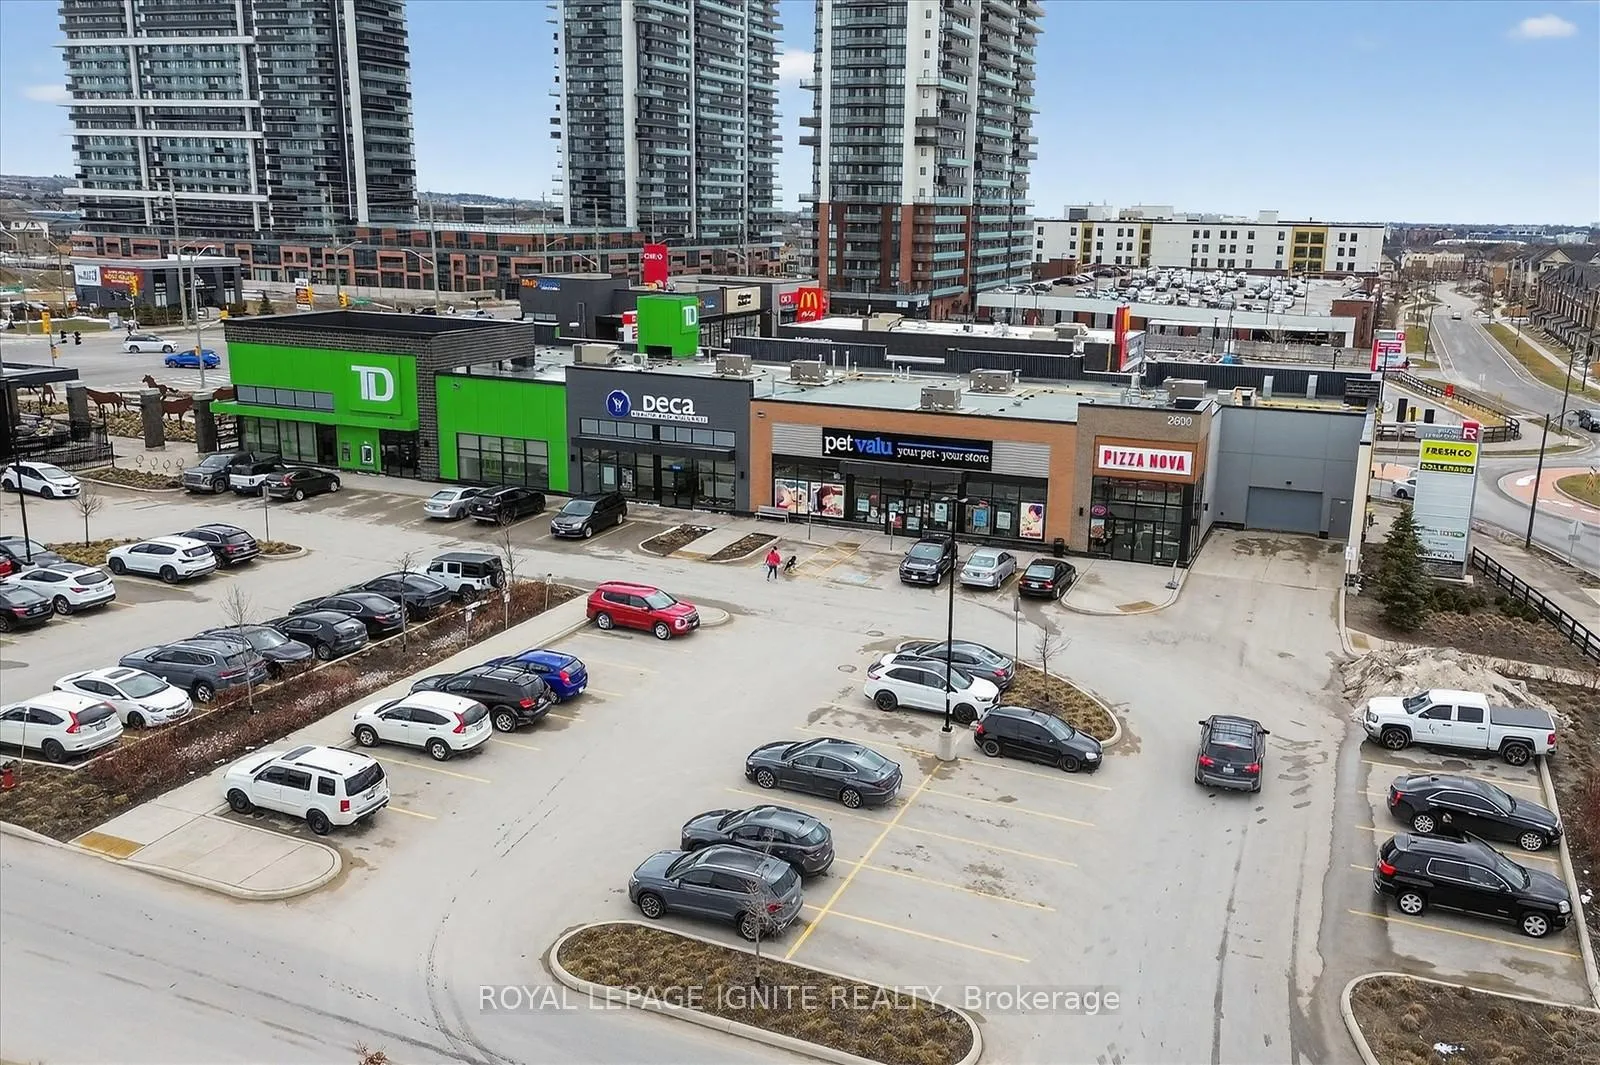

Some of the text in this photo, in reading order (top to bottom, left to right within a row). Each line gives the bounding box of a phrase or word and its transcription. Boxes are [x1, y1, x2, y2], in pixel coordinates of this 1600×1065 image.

[682, 305, 697, 327] TD
[351, 365, 394, 402] TD
[642, 395, 696, 415] Deca
[1167, 415, 1193, 426] 2600
[1462, 427, 1477, 440] R
[824, 434, 893, 455] pet valu
[897, 447, 919, 458] your
[964, 451, 989, 463] store
[1103, 449, 1185, 472] PIZZA NOVA
